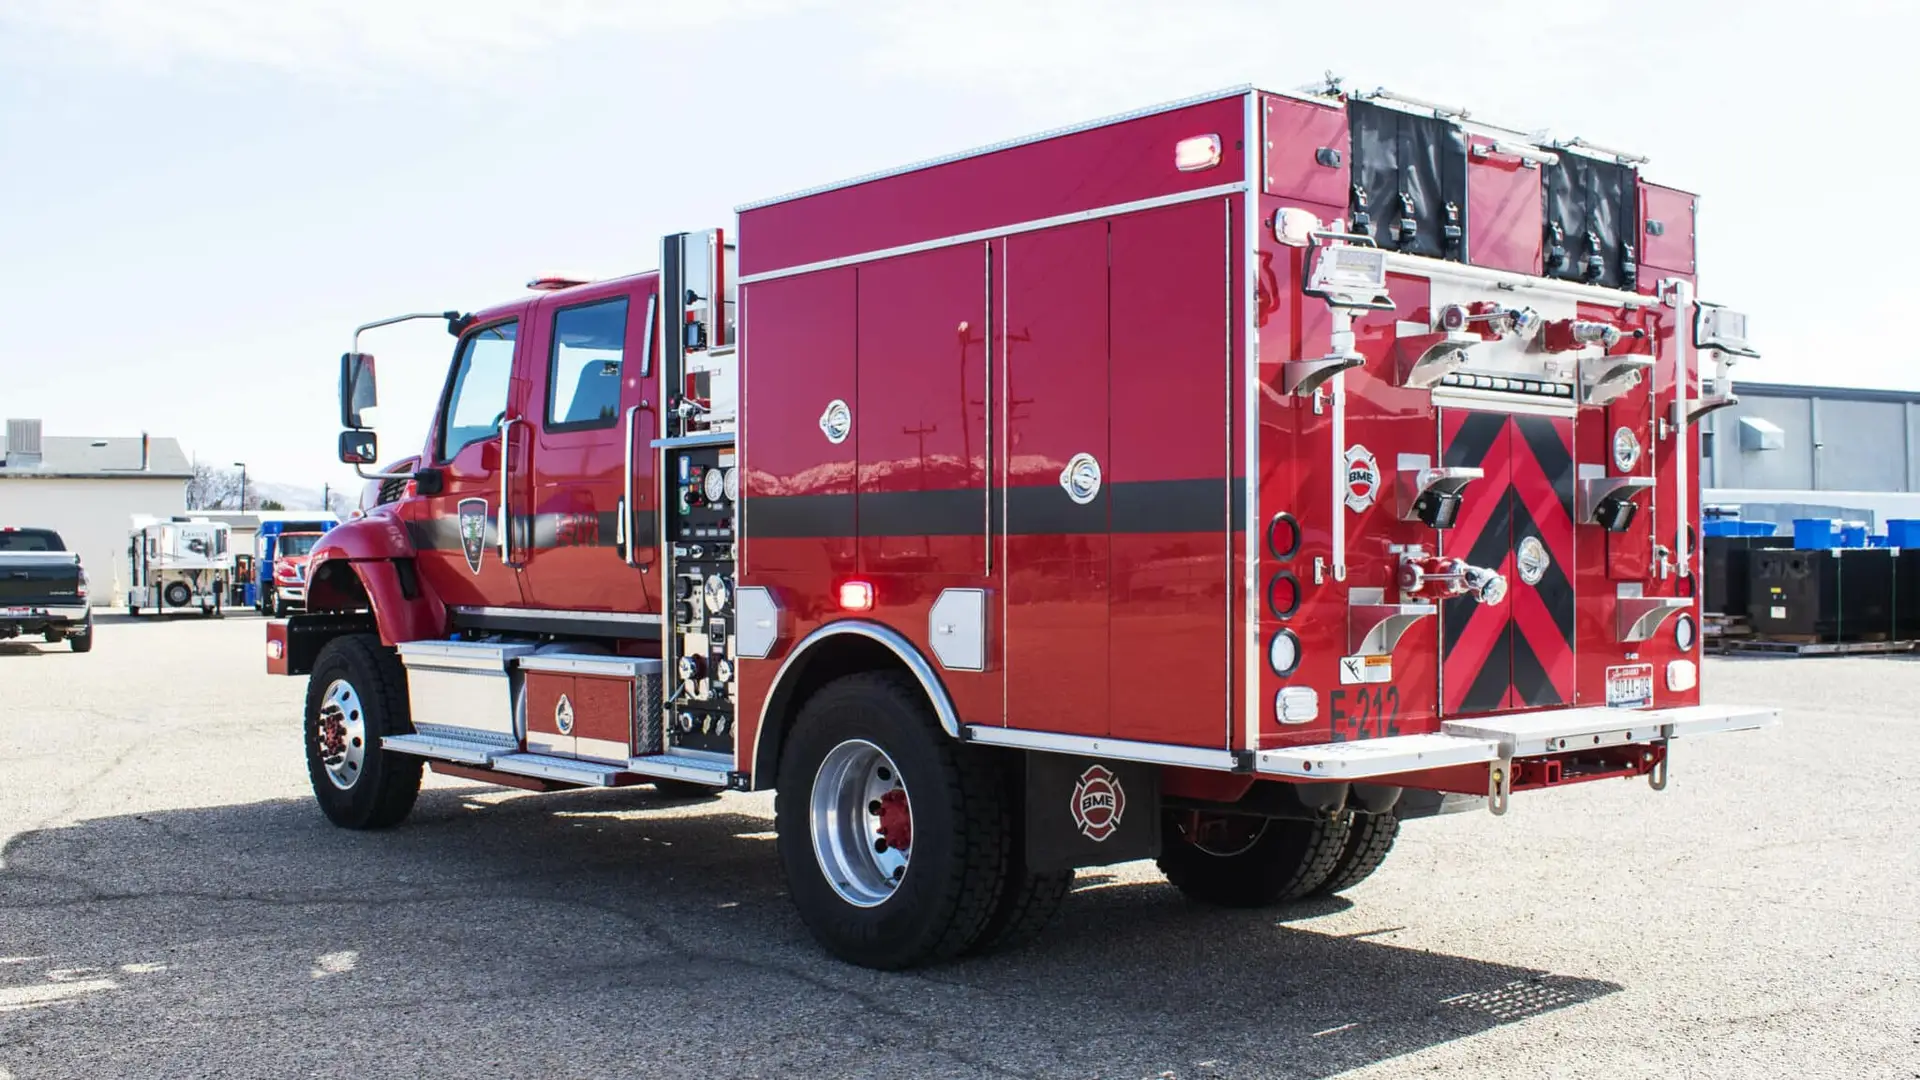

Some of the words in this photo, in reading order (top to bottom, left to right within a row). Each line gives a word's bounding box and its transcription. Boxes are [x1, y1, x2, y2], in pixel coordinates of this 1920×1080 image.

[1349, 471, 1374, 484] BME
[1330, 685, 1400, 743] E-212
[1082, 795, 1114, 810] BME
